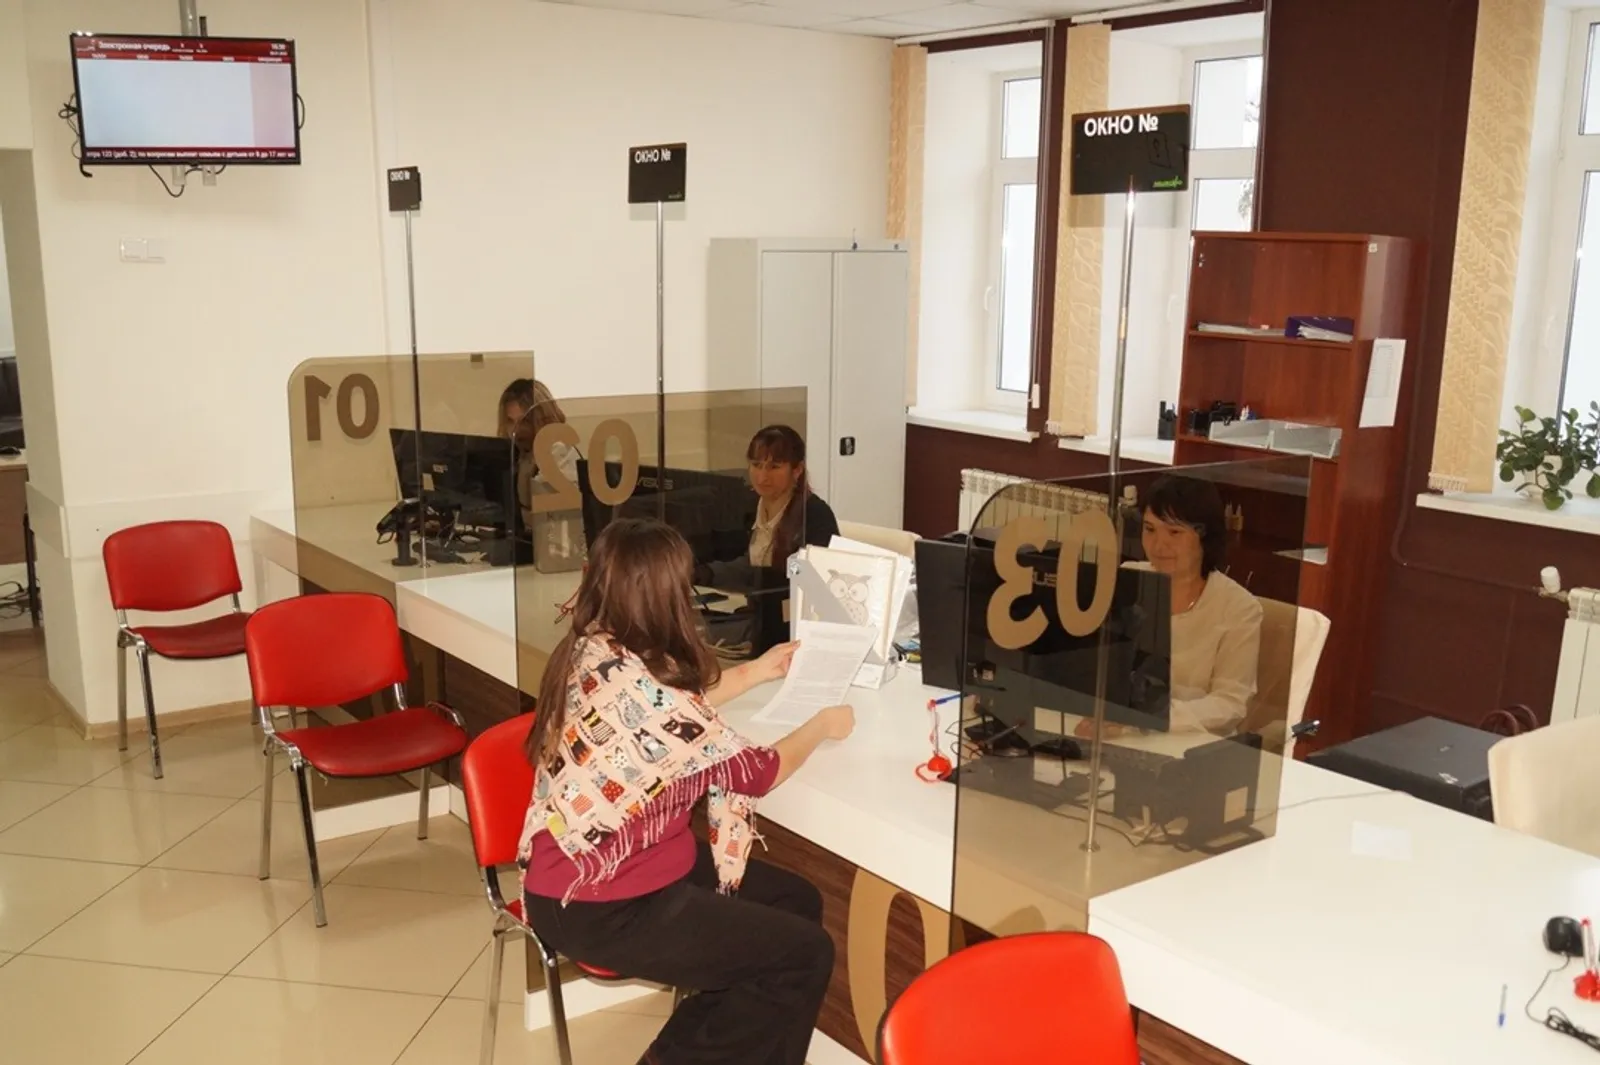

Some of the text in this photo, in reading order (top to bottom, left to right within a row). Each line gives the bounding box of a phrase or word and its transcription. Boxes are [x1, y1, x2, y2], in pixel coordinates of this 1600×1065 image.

[1084, 113, 1159, 137] ОКНО №
[634, 149, 660, 163] ОКНО
